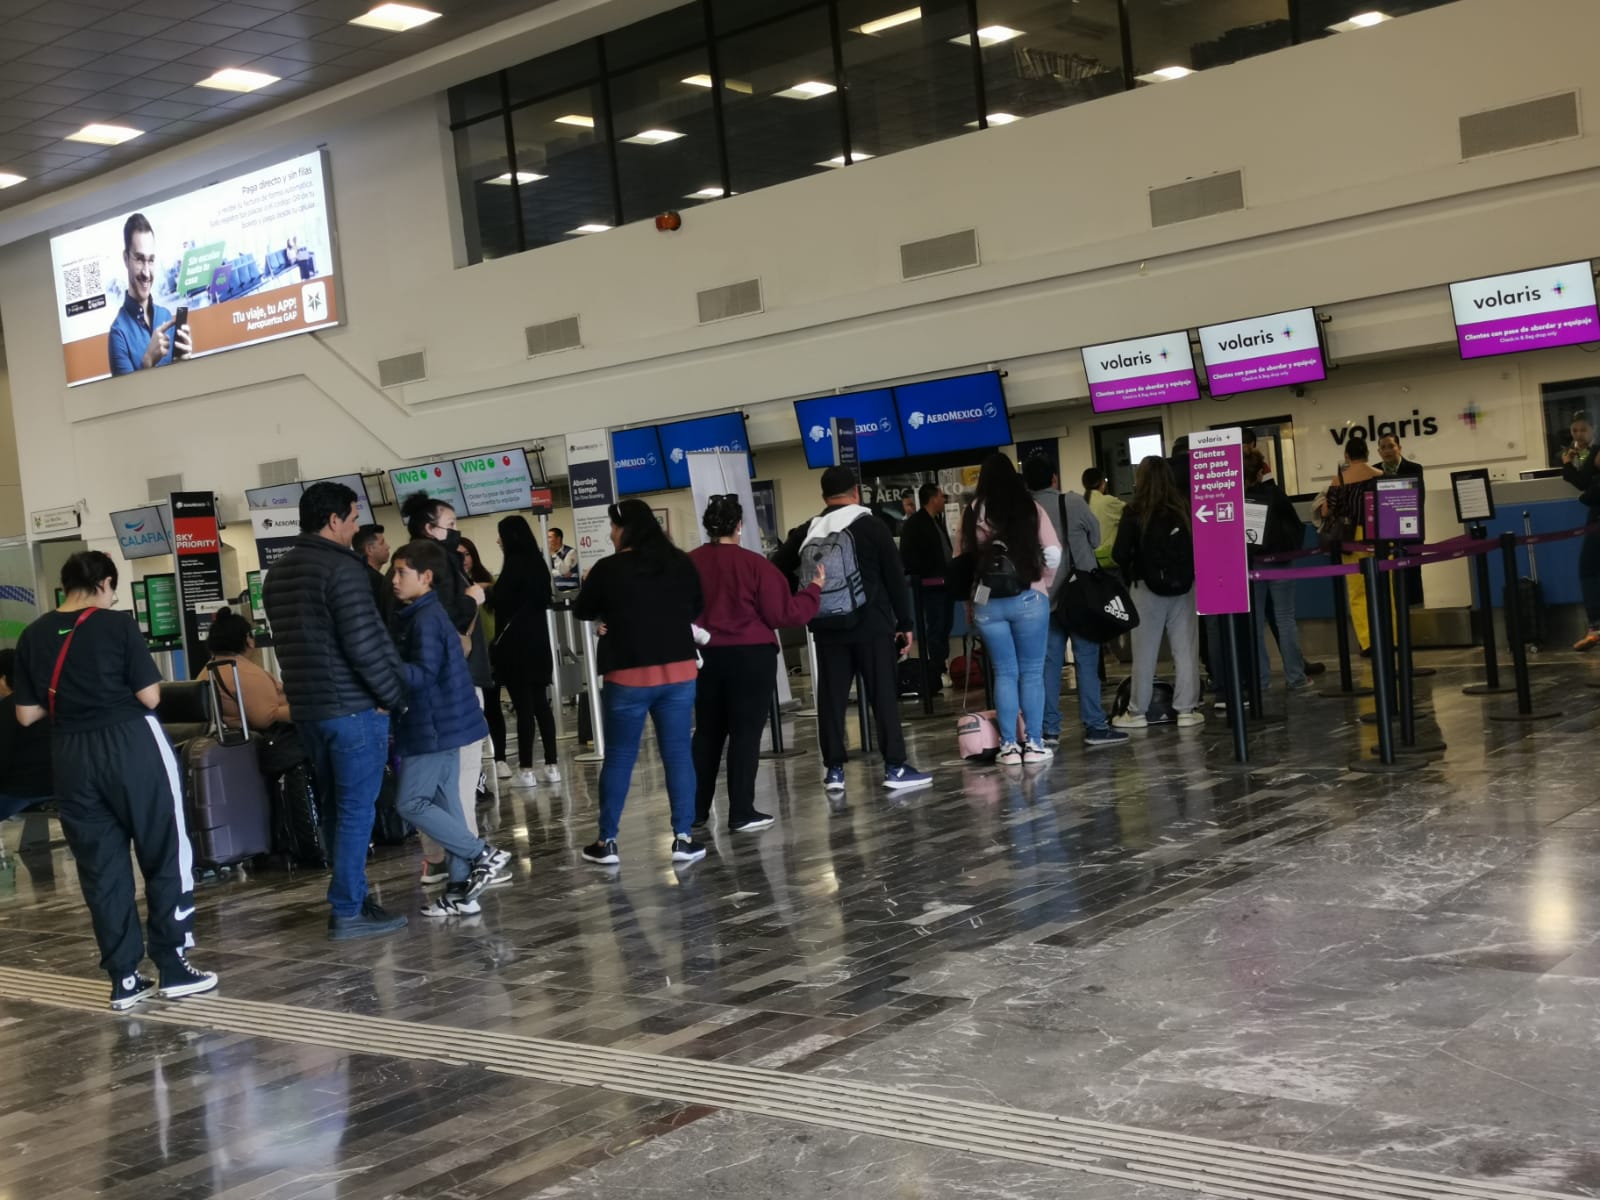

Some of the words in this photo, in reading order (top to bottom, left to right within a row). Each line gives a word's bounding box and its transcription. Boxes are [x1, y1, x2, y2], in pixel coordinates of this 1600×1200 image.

[259, 176, 281, 190] directo
[288, 171, 298, 180] sin
[298, 166, 313, 177] filas
[1473, 285, 1542, 309] volaris
[245, 306, 267, 321] viaje,
[267, 303, 276, 315] tu
[277, 297, 298, 313] APP!
[247, 316, 283, 331] Aeropuertos
[283, 311, 298, 322] GAP
[1464, 333, 1490, 341] Clientes
[1503, 328, 1519, 336] pase
[1520, 325, 1529, 333] de
[1530, 323, 1556, 332] abordar
[1563, 317, 1592, 327] equipaje
[1218, 329, 1274, 351] volaris
[1100, 351, 1152, 371] volaris
[1212, 372, 1234, 380] Clientes
[1266, 363, 1288, 372] abordar
[1293, 358, 1317, 367] equipaje
[1095, 390, 1115, 398] Clientes
[1125, 387, 1137, 395] pase
[1145, 383, 1165, 391] abordar
[1169, 379, 1192, 387] equipaje
[926, 407, 983, 424] AEROMEXICO
[826, 422, 878, 438] AEXICO
[1330, 409, 1439, 446] volaris
[1197, 434, 1223, 445] volaris
[1193, 449, 1226, 460] Clientes
[1193, 461, 1209, 471] con
[1209, 459, 1229, 471] pase
[572, 477, 597, 487] Abordaje
[1193, 470, 1205, 481] de
[1206, 468, 1239, 480] abordar
[578, 486, 597, 495] tiempo
[1193, 483, 1200, 493] y
[1201, 479, 1236, 493] equipaje
[175, 533, 193, 542] SKY
[176, 539, 216, 549] PRIORITY
[579, 535, 592, 548] 40
